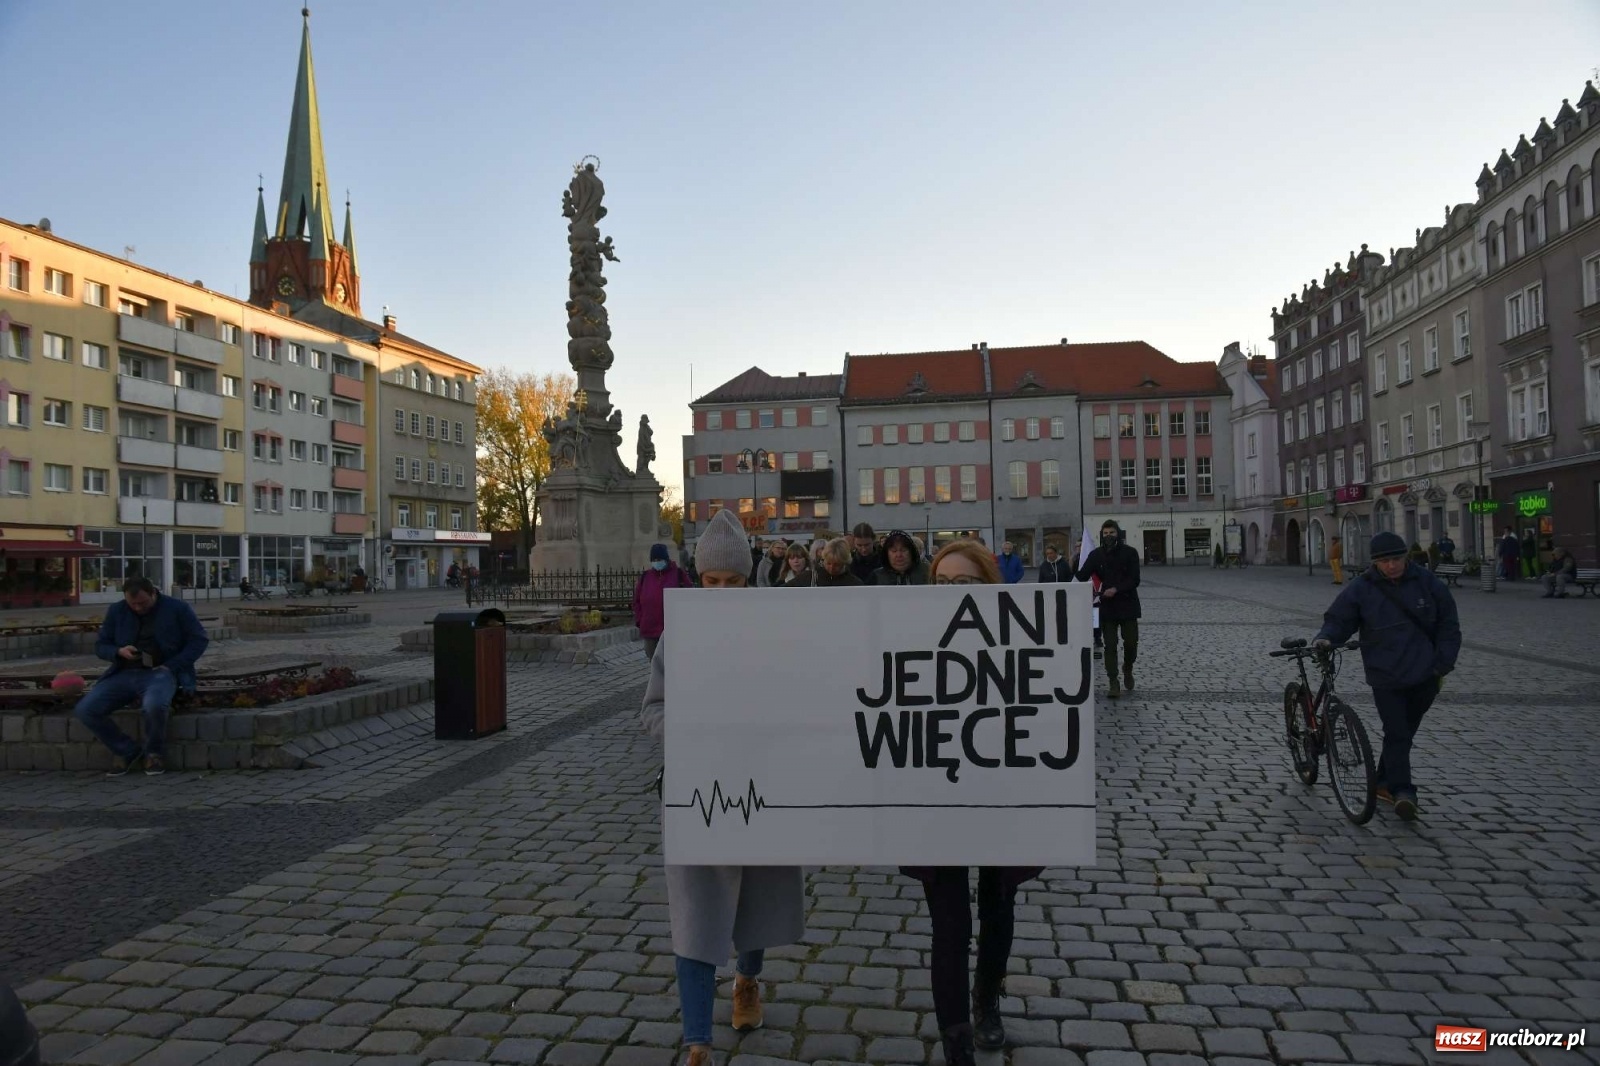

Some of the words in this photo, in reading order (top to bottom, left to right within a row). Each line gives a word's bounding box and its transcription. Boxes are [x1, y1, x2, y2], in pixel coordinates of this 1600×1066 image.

[1519, 495, 1547, 510] żabka
[196, 539, 218, 551] empik
[938, 589, 1068, 648] ANI
[856, 647, 1091, 707] JEDNEJ
[855, 706, 1080, 783] WIĘCEJ
